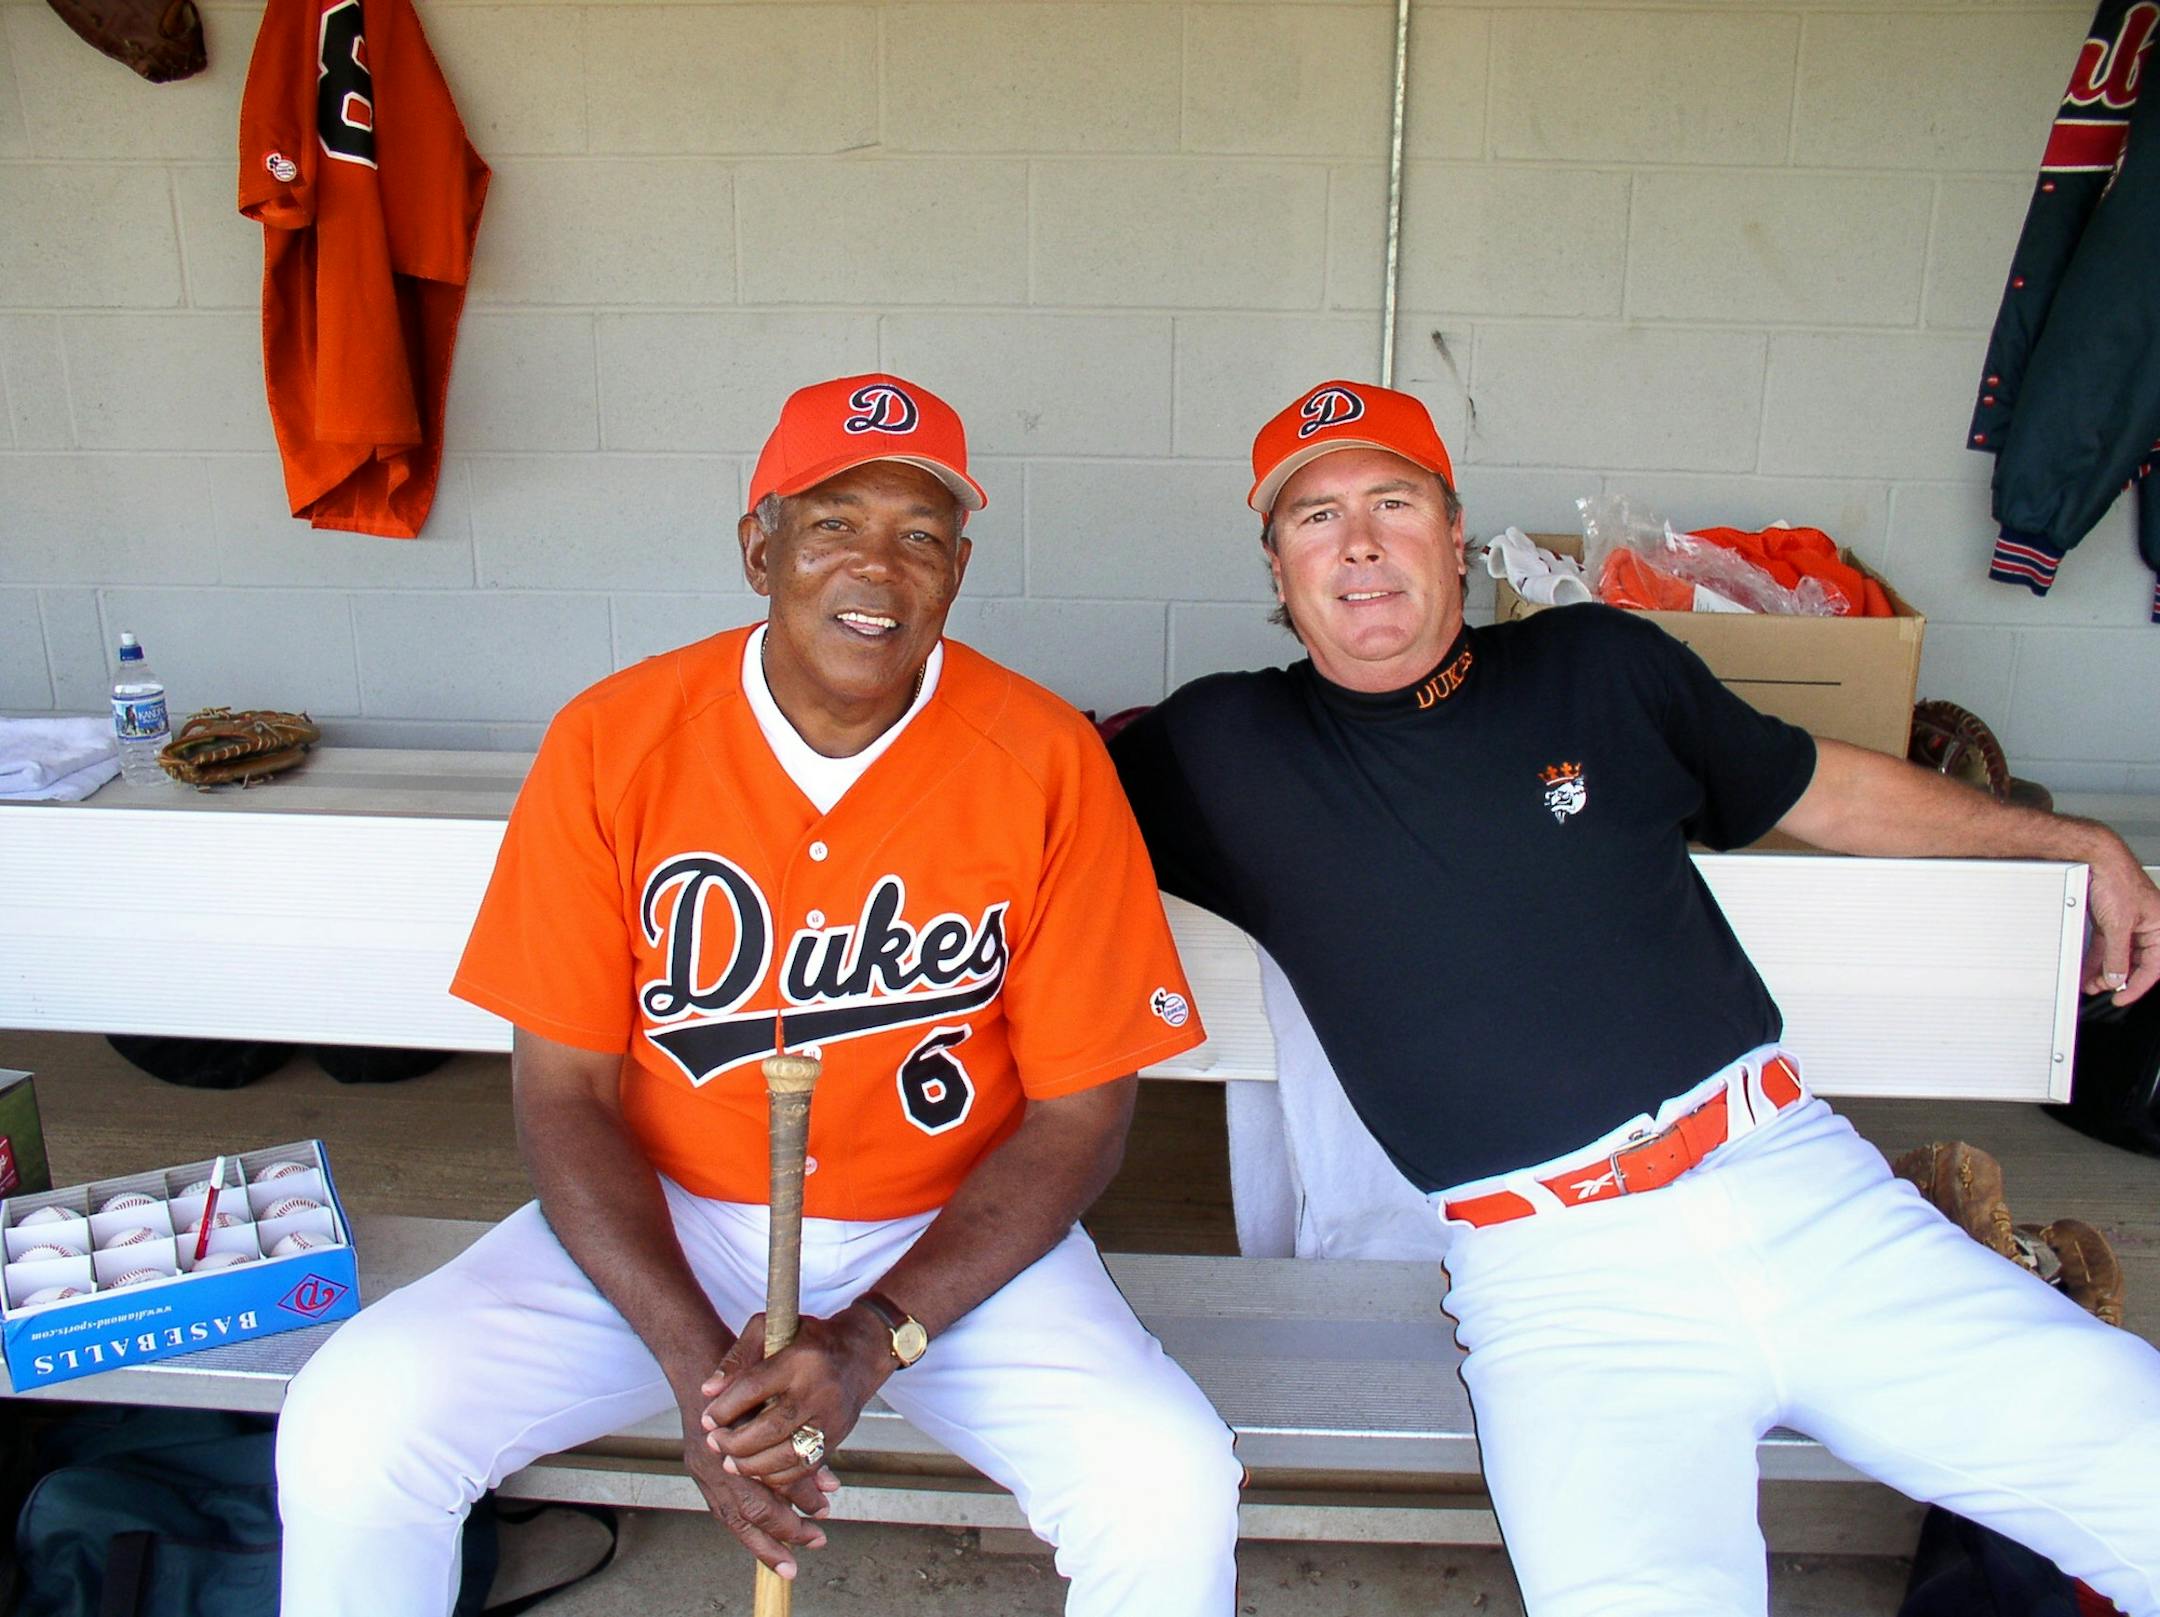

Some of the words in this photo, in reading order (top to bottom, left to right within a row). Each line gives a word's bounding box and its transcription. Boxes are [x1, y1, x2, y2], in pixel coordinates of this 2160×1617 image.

[317, 0, 378, 171] 8
[844, 383, 919, 435] D
[1298, 386, 1365, 439] D
[640, 850, 1010, 1022] Dukes
[896, 1023, 975, 1136] 6
[31, 1304, 173, 1341] www.diamond-sports.com
[34, 1309, 260, 1376] BASEBALLS
